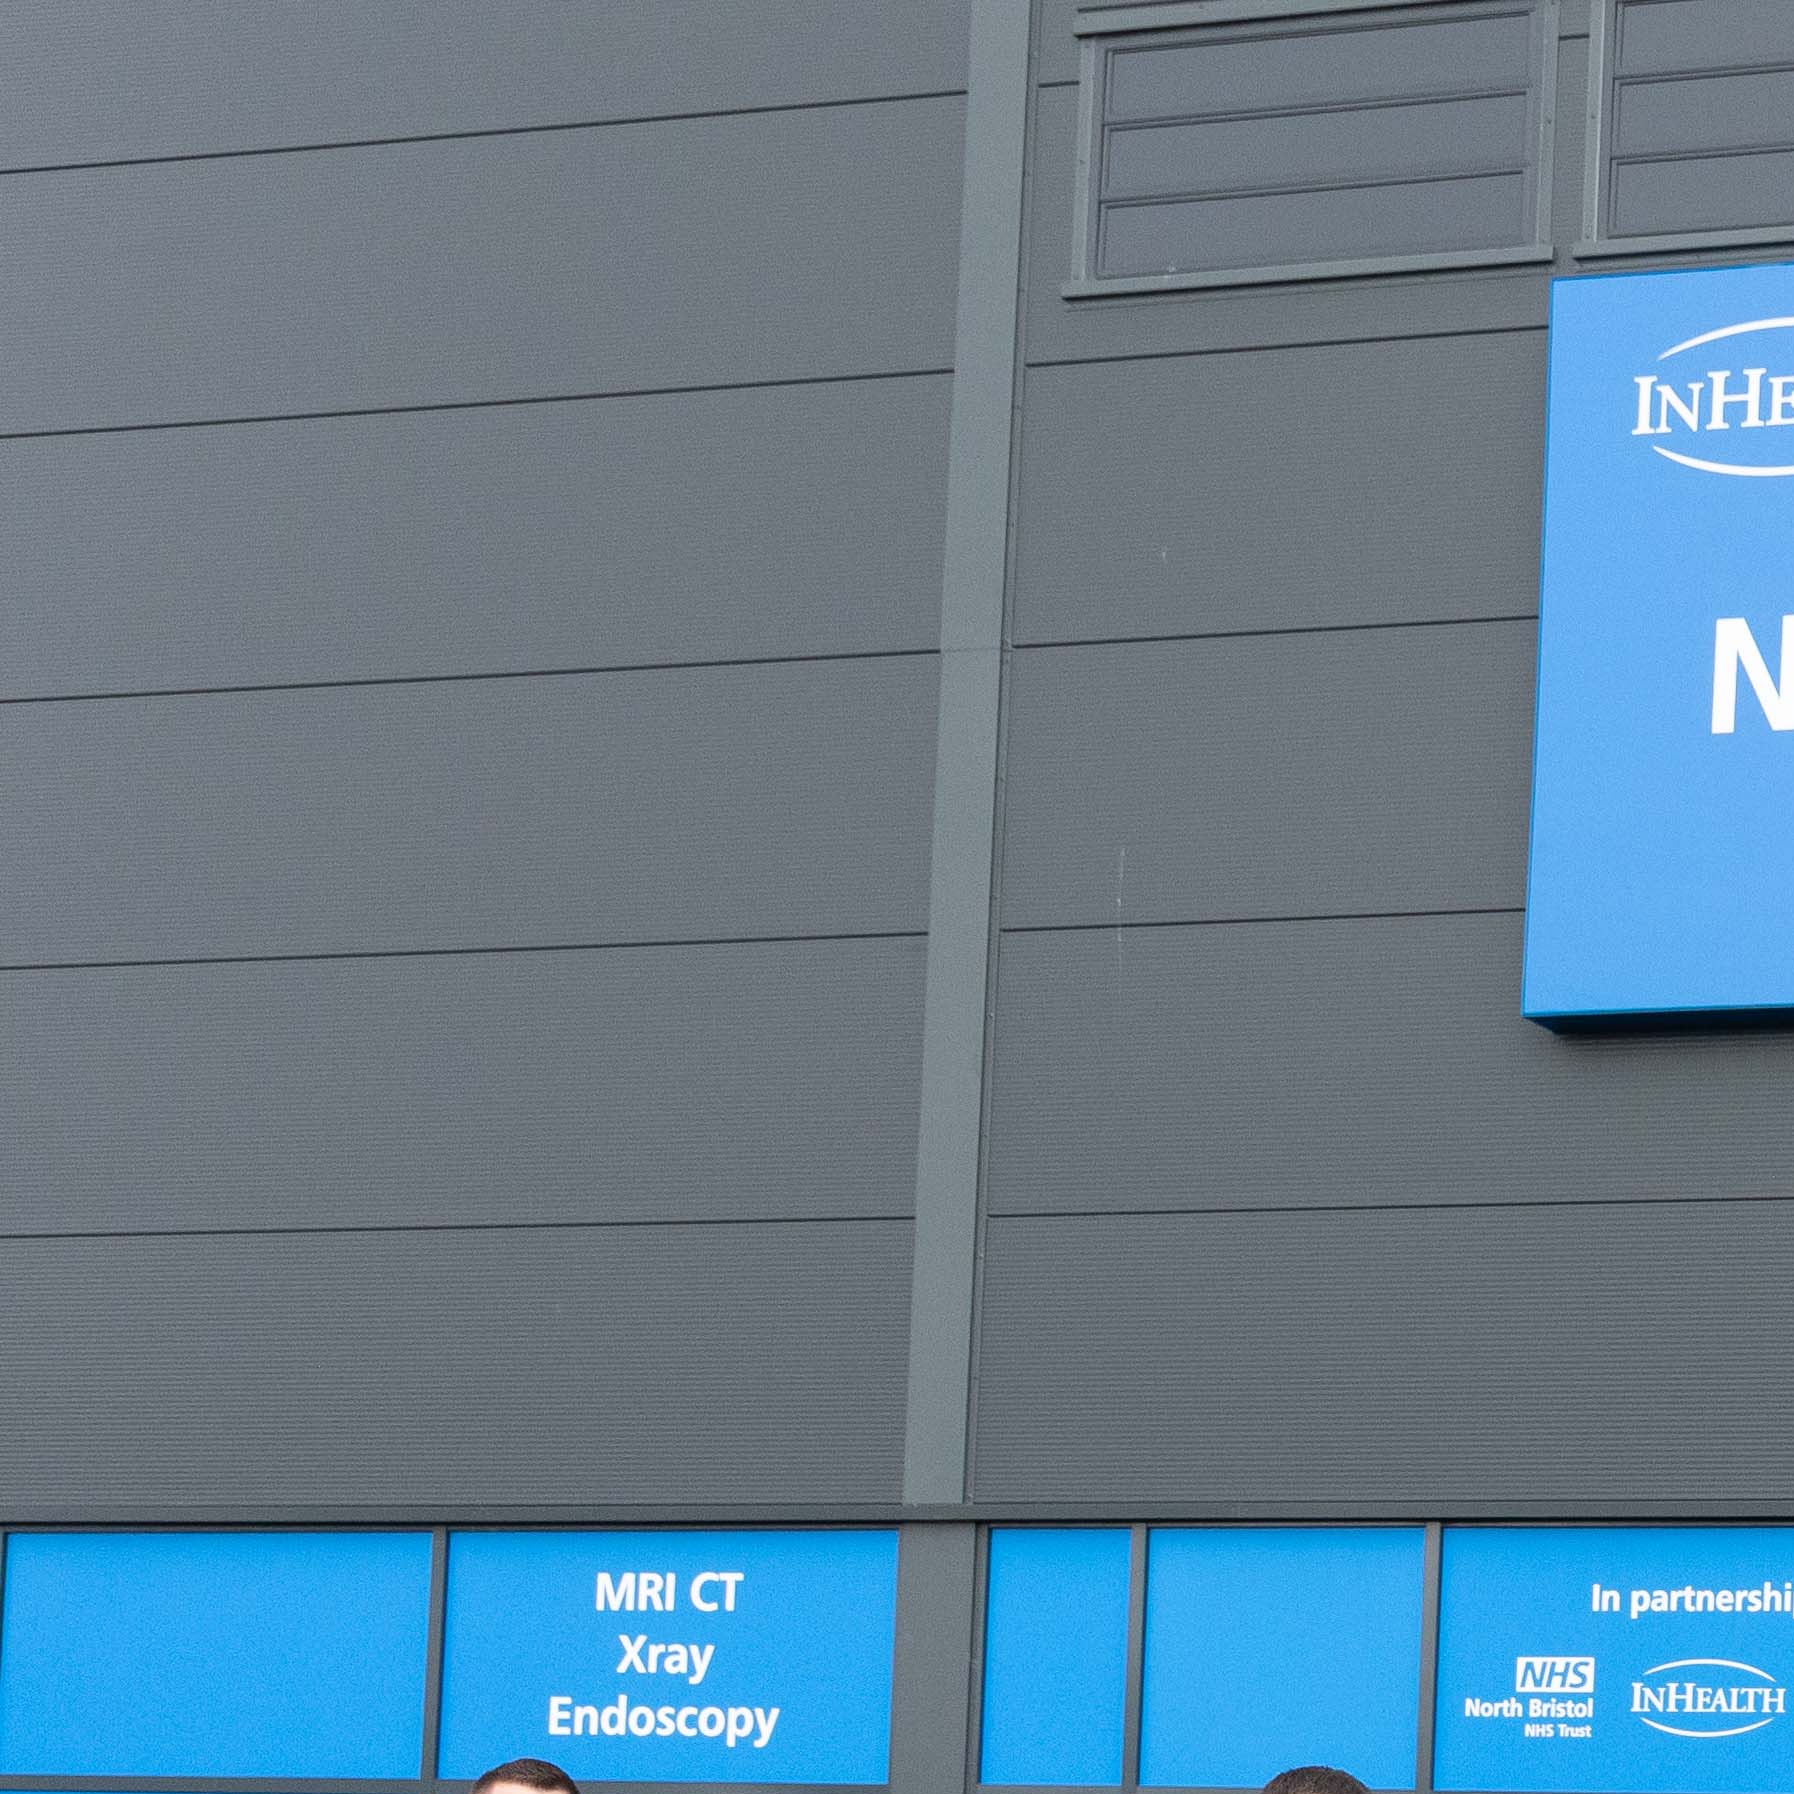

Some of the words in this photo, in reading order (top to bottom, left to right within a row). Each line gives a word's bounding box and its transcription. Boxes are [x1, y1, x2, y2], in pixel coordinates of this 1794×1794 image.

[595, 1572, 676, 1612] MRI
[690, 1571, 744, 1612] CT
[1591, 1583, 1621, 1612] In
[616, 1634, 715, 1685] Xray
[1519, 1661, 1590, 1689] NHS
[548, 1694, 780, 1748] Endoscopy
[1464, 1697, 1523, 1718] North
[1528, 1697, 1594, 1718] Bristol
[1524, 1724, 1555, 1738] NHS
[1557, 1724, 1592, 1738] Trust
